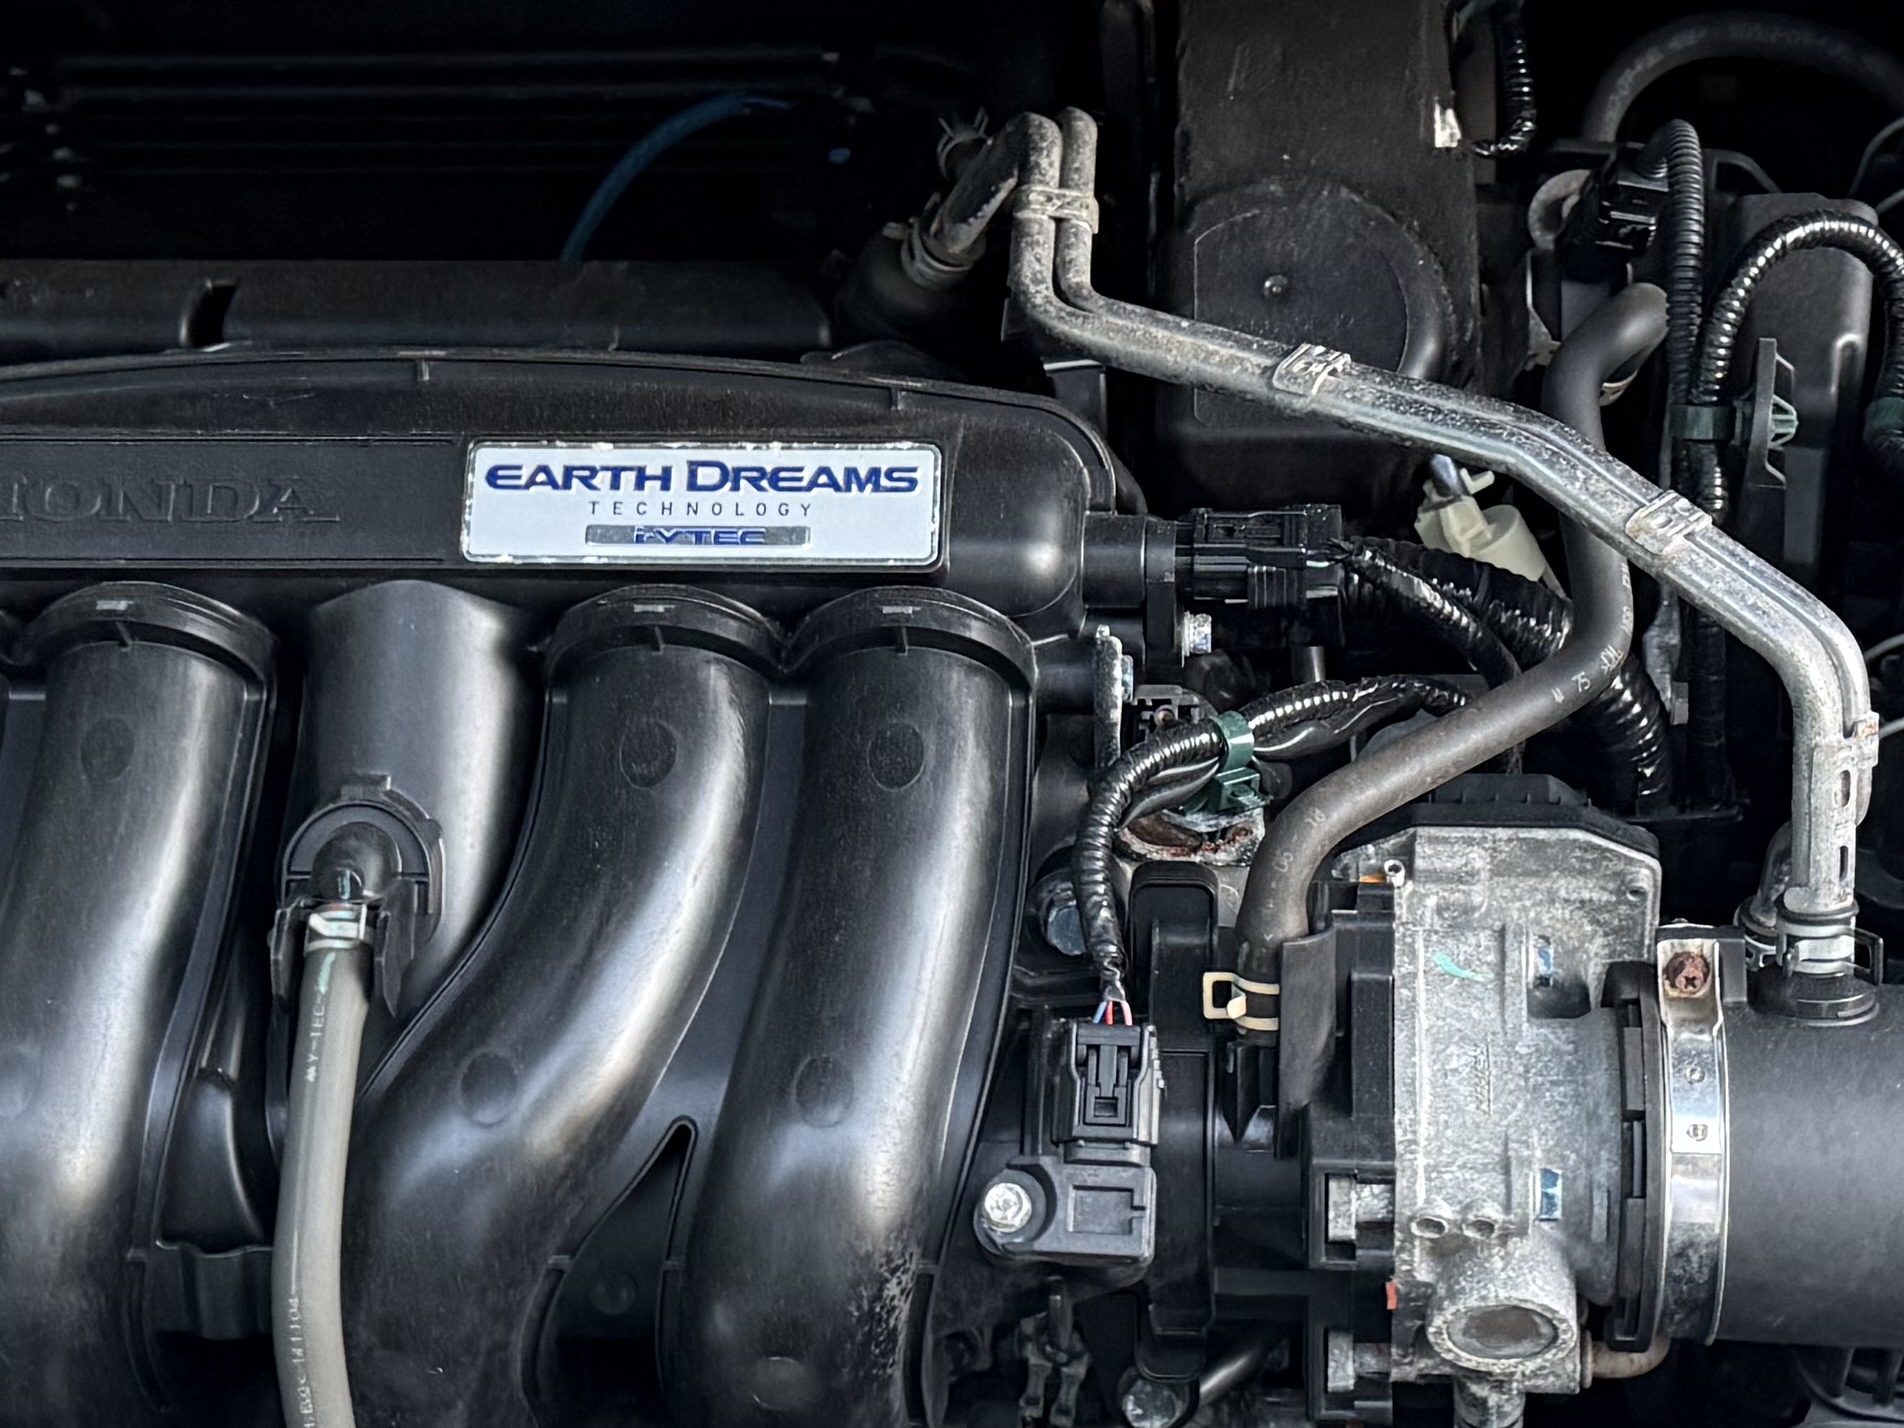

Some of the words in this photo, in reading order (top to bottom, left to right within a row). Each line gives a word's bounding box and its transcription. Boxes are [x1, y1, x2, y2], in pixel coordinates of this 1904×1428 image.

[484, 462, 675, 494] EARTH
[686, 458, 919, 494] DREAMS
[589, 501, 814, 517] TECHNOLOGY
